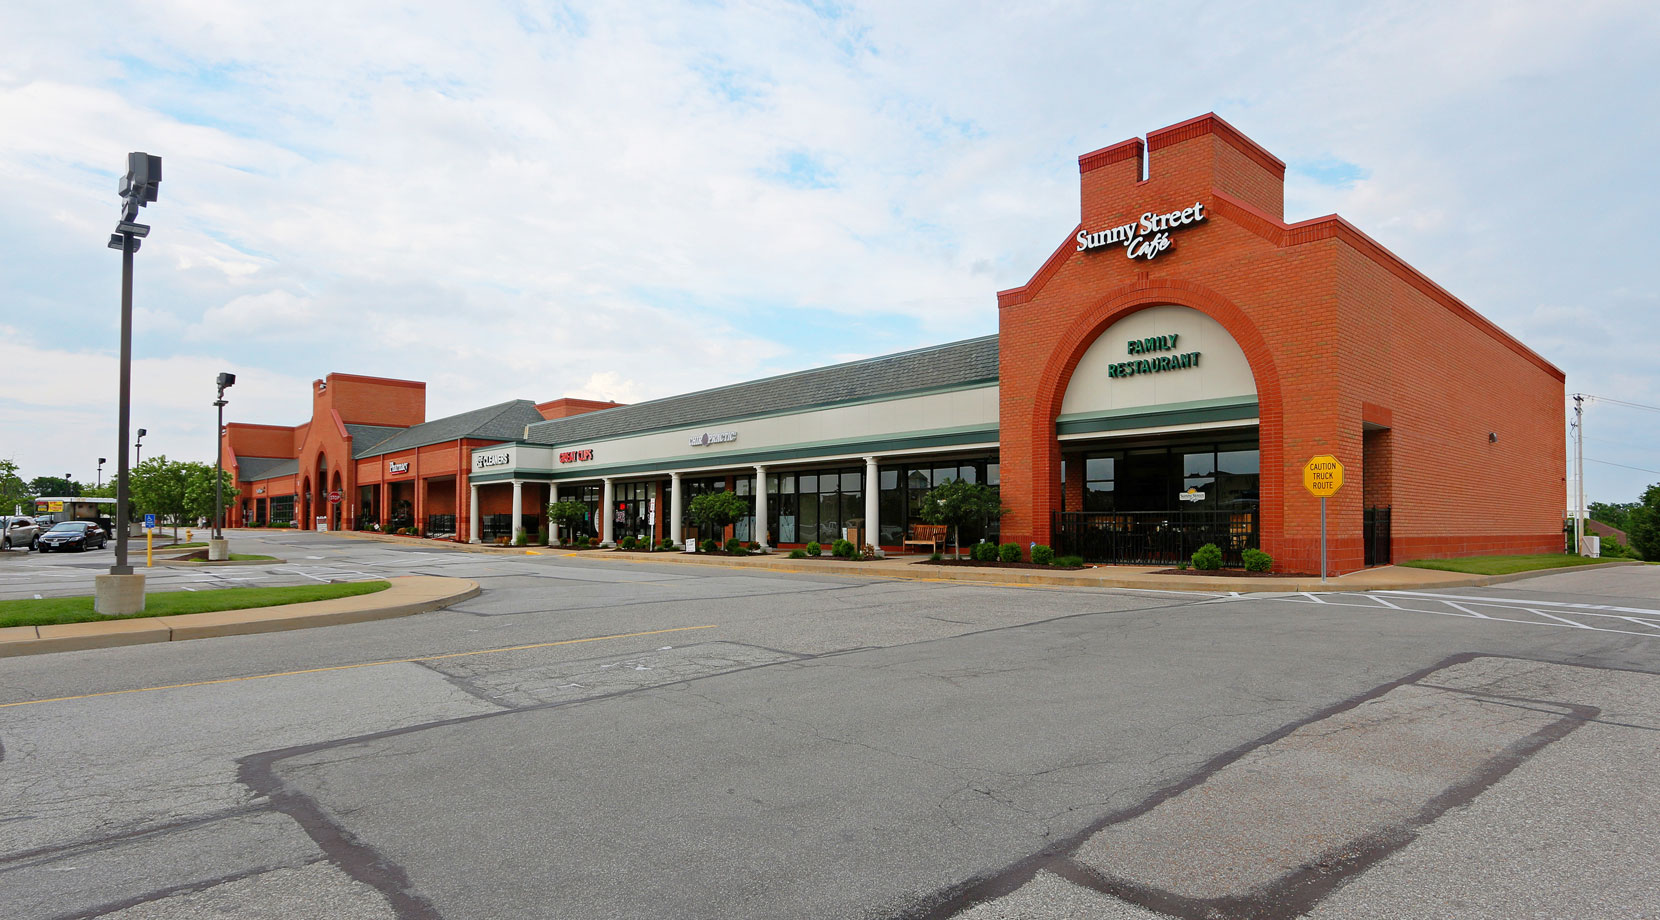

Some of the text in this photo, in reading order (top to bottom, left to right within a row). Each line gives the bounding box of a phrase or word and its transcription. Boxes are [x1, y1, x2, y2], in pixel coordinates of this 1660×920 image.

[1076, 202, 1205, 251] Sunny Street
[1126, 232, 1171, 260] Café
[1127, 334, 1179, 355] FAMILY
[1107, 352, 1202, 378] RESTAURANT
[484, 453, 509, 466] CLEANERS
[559, 449, 593, 463] GREAT CLIPS
[389, 461, 409, 473] Pharmacy
[1310, 463, 1336, 471] CAUTION
[1313, 472, 1333, 480] TRUCK
[1312, 481, 1333, 489] ROUTE
